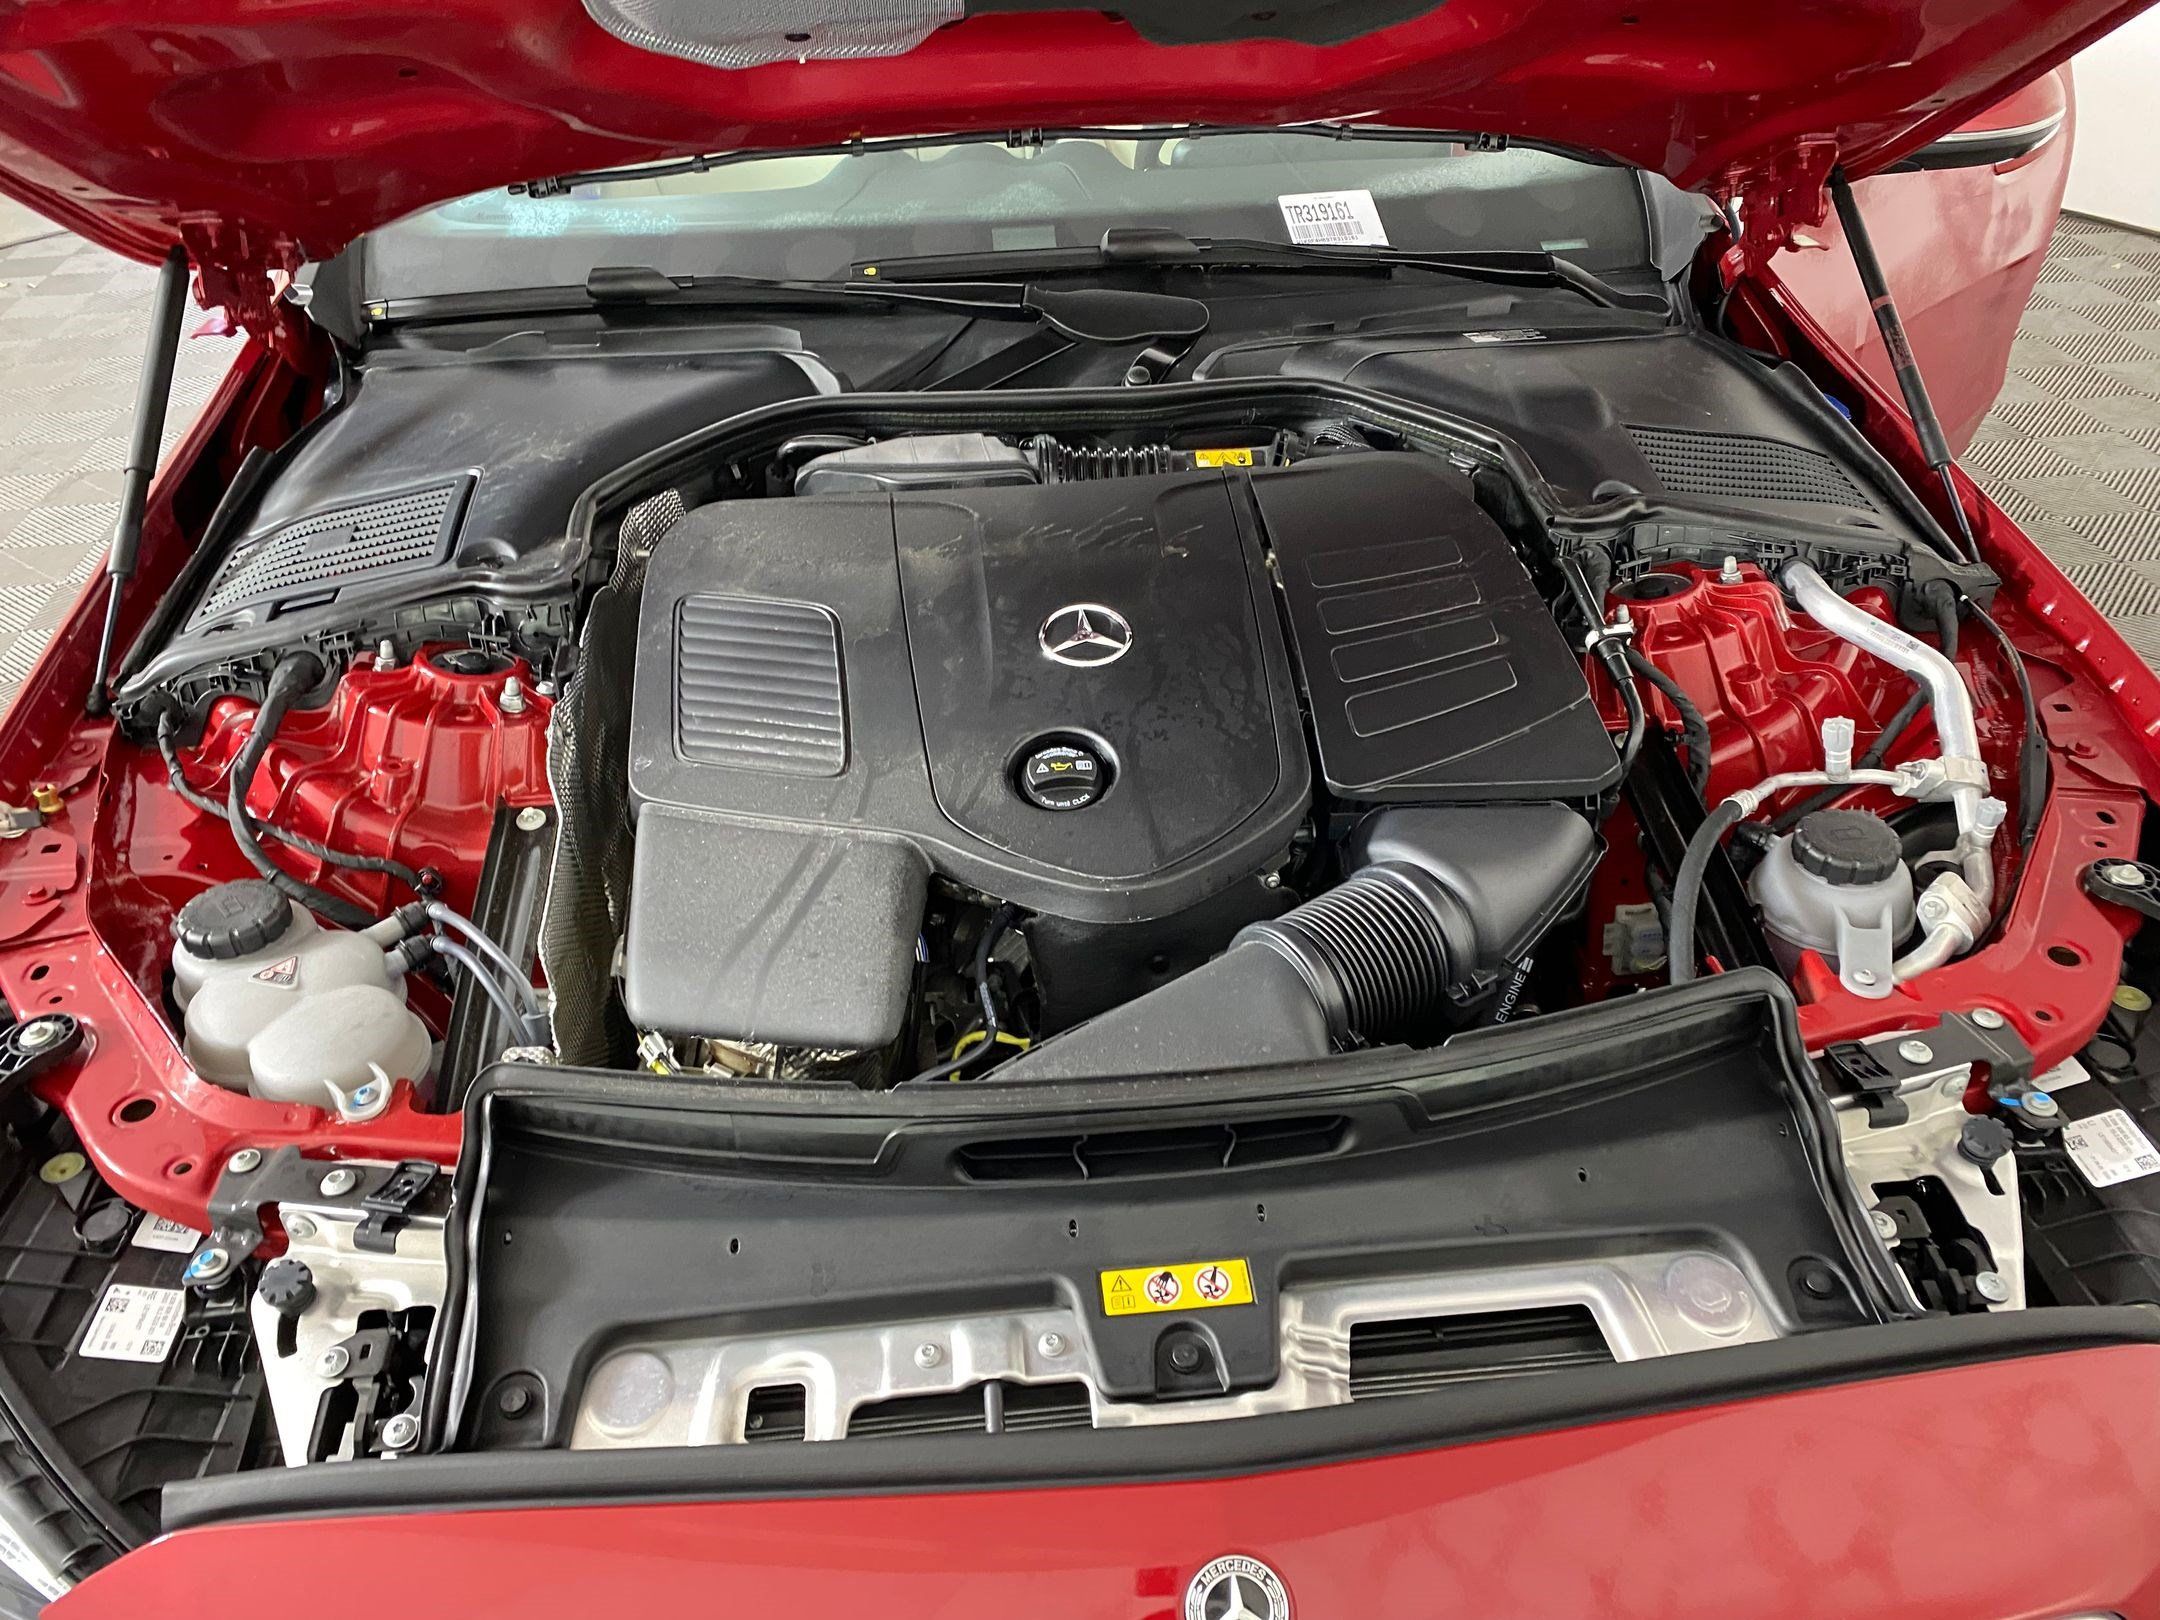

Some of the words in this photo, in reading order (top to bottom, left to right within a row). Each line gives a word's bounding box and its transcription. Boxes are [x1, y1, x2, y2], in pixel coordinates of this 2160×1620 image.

[1285, 201, 1354, 224] TR319161
[1496, 972, 1526, 1023] ENGINE
[1201, 1560, 1266, 1586] MERCEDES
